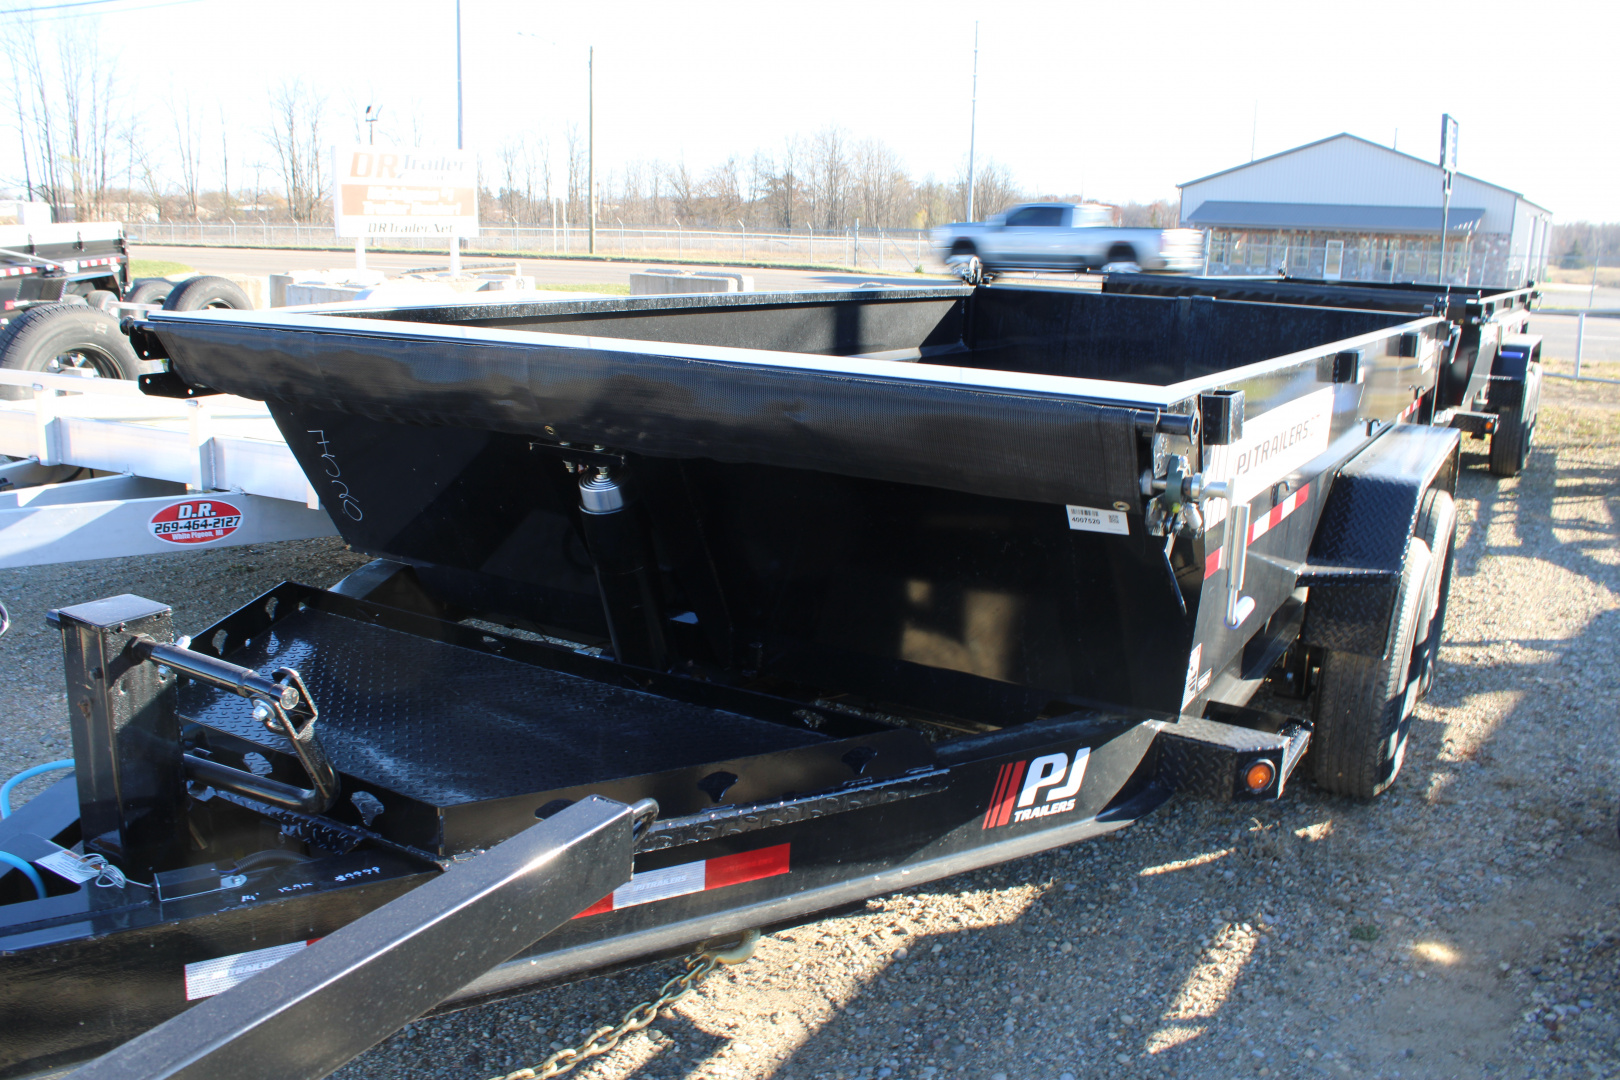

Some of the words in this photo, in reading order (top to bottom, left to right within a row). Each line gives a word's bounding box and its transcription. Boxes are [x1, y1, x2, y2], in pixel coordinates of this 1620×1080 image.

[350, 151, 399, 179] DR
[404, 154, 467, 171] Trailer
[177, 502, 217, 519] D.R.
[154, 516, 241, 534] 269-464-2127
[172, 532, 191, 540] White
[215, 528, 224, 536] MI
[1017, 746, 1091, 808] PJ
[1014, 798, 1076, 823] TRAILERS
[645, 875, 687, 889] TRAILERS
